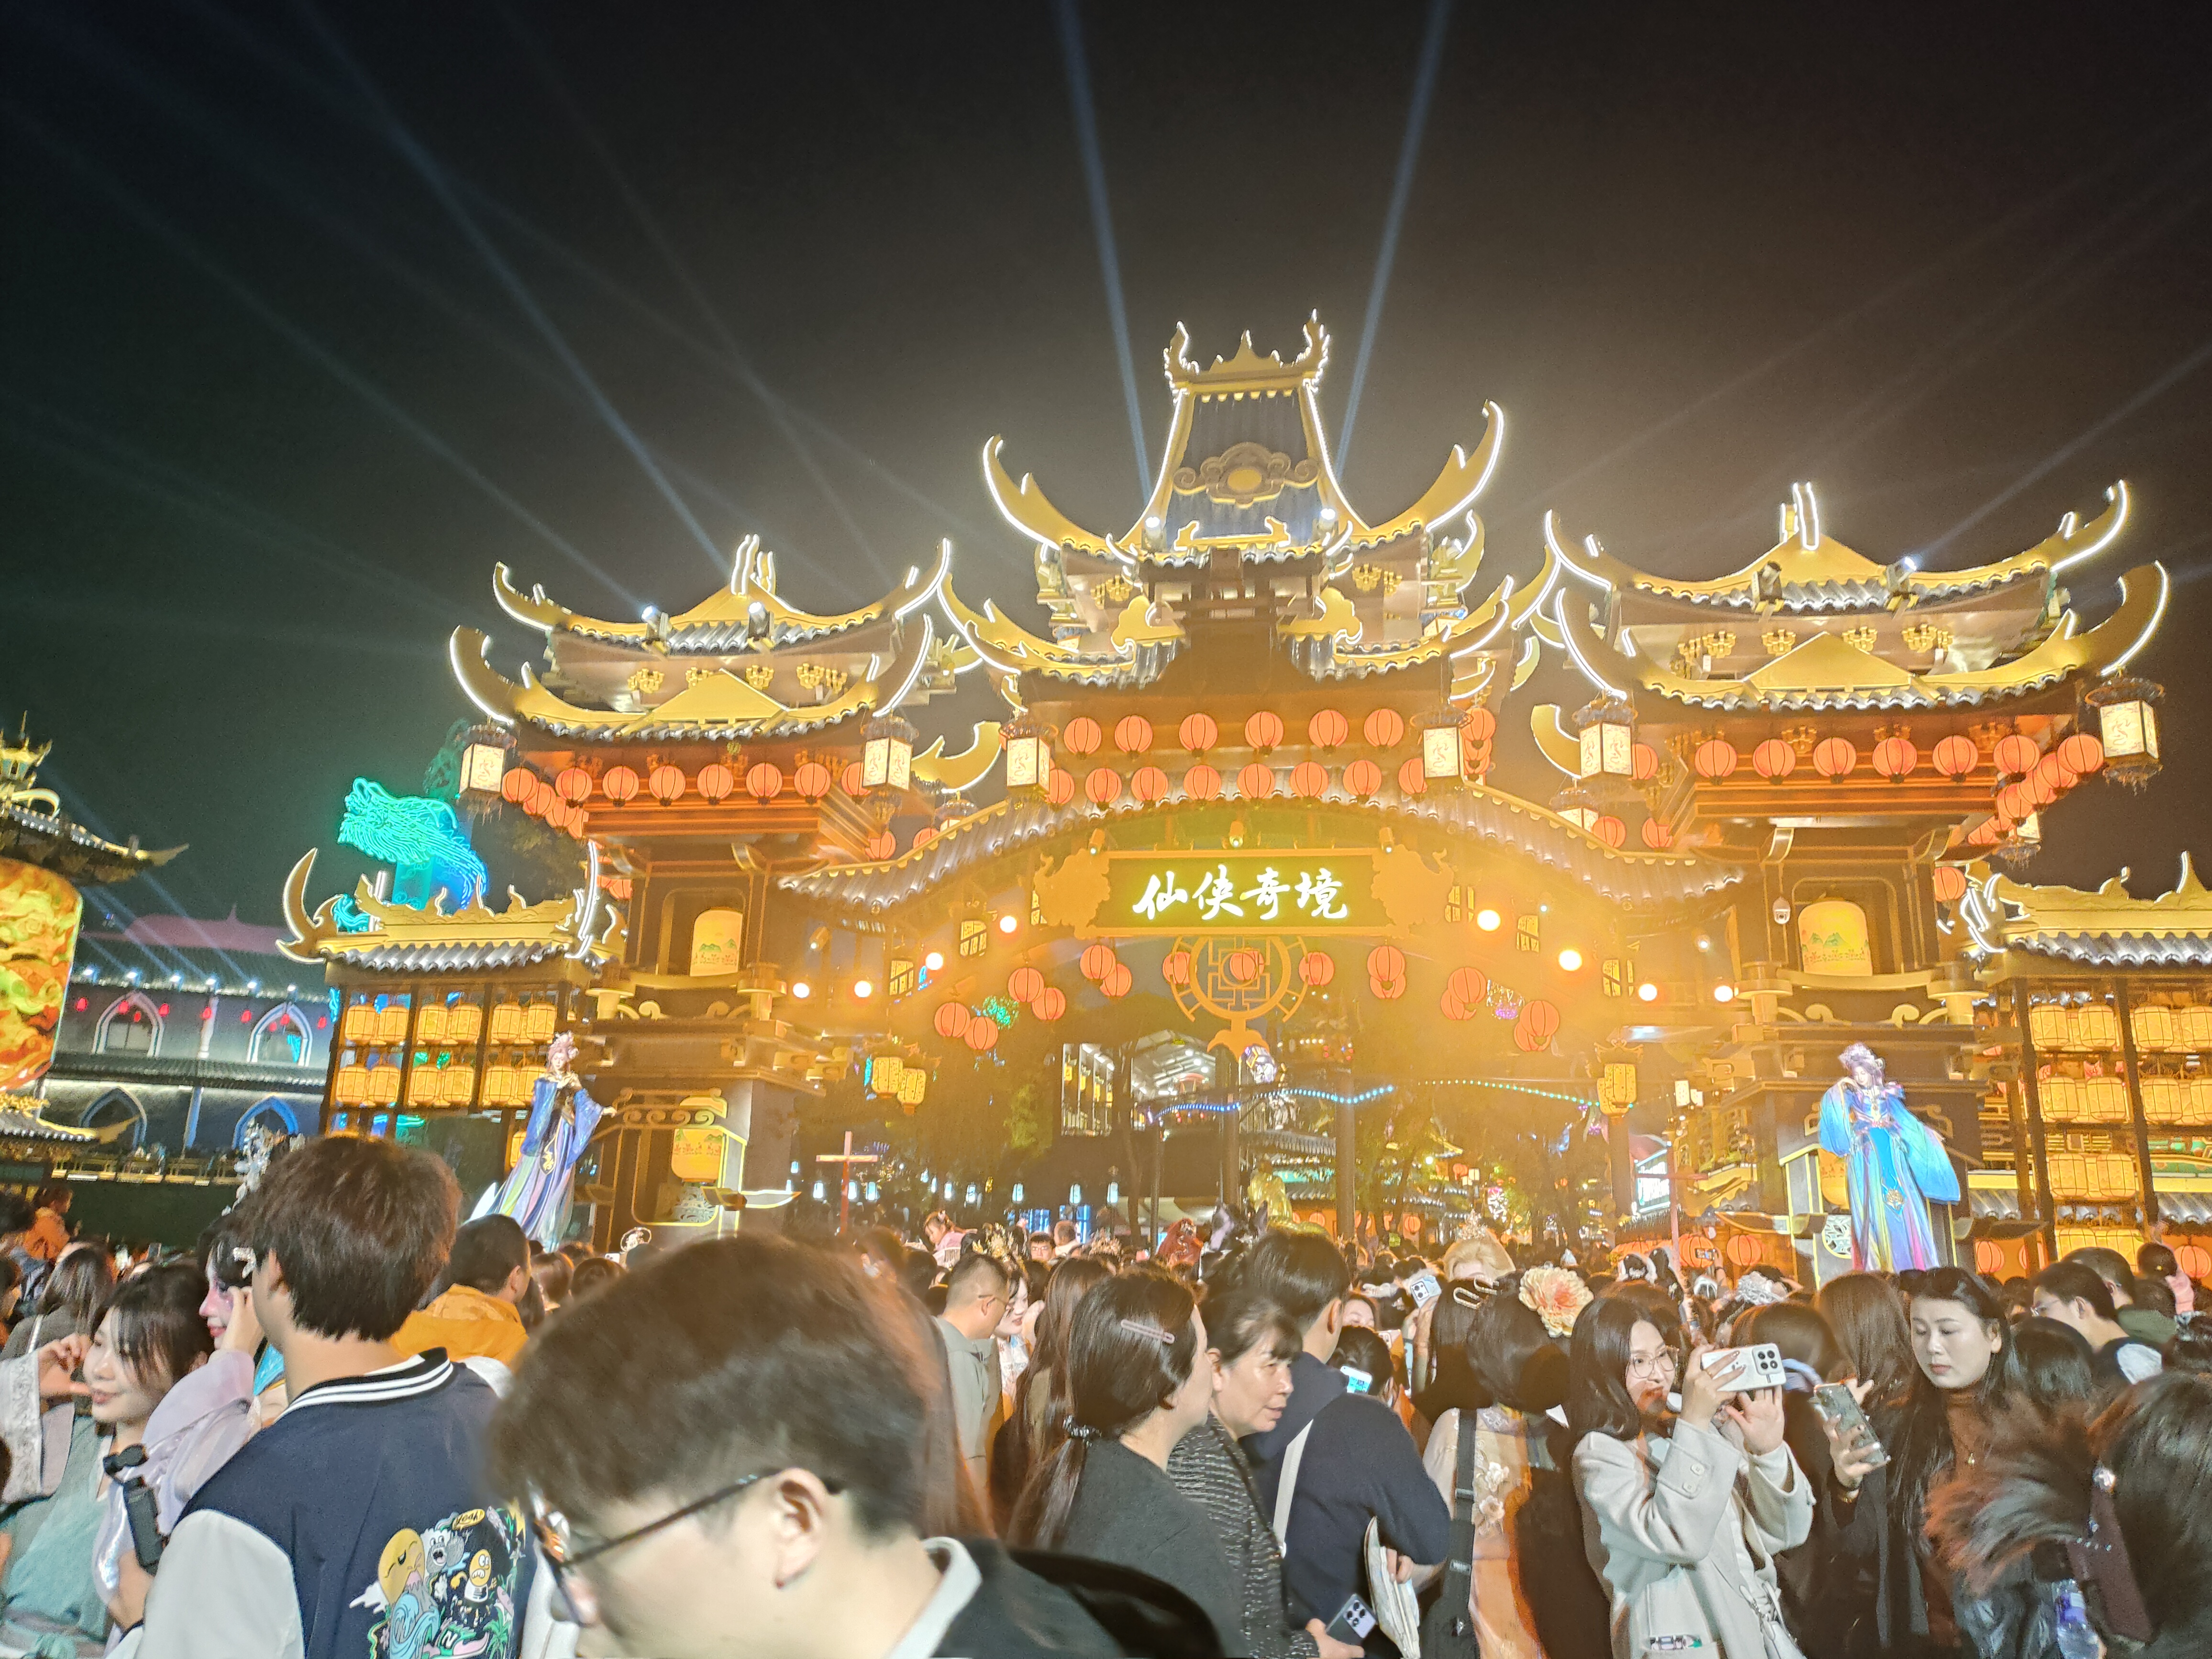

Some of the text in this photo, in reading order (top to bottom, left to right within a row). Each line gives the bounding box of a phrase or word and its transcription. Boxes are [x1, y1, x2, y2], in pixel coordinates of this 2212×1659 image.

[1132, 864, 1348, 920] 仙侠奇境
[442, 1630, 458, 1648] N
